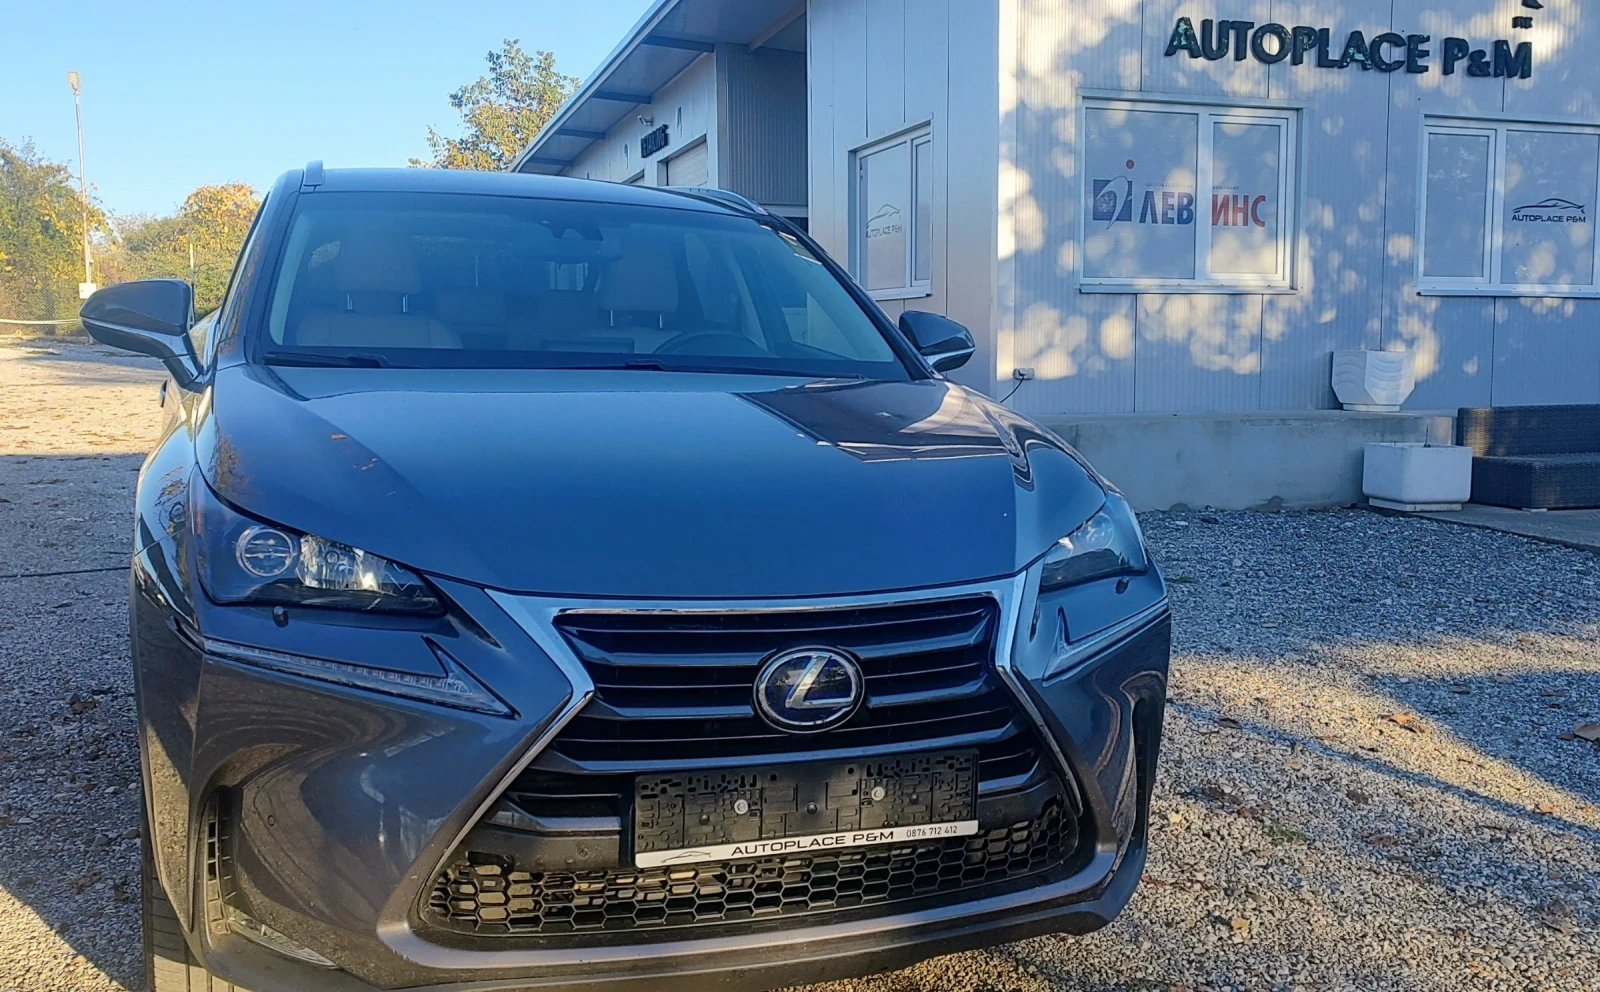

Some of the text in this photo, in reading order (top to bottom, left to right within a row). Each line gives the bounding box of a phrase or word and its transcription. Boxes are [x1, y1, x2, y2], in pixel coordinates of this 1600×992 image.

[1164, 16, 1532, 80] AUTOPLACE P&M
[1139, 191, 1266, 227] ЛЕВ ИНС
[1511, 214, 1564, 223] AUTOPLACE
[731, 825, 958, 857] AUTOPLACE P&M 0876 712 412
